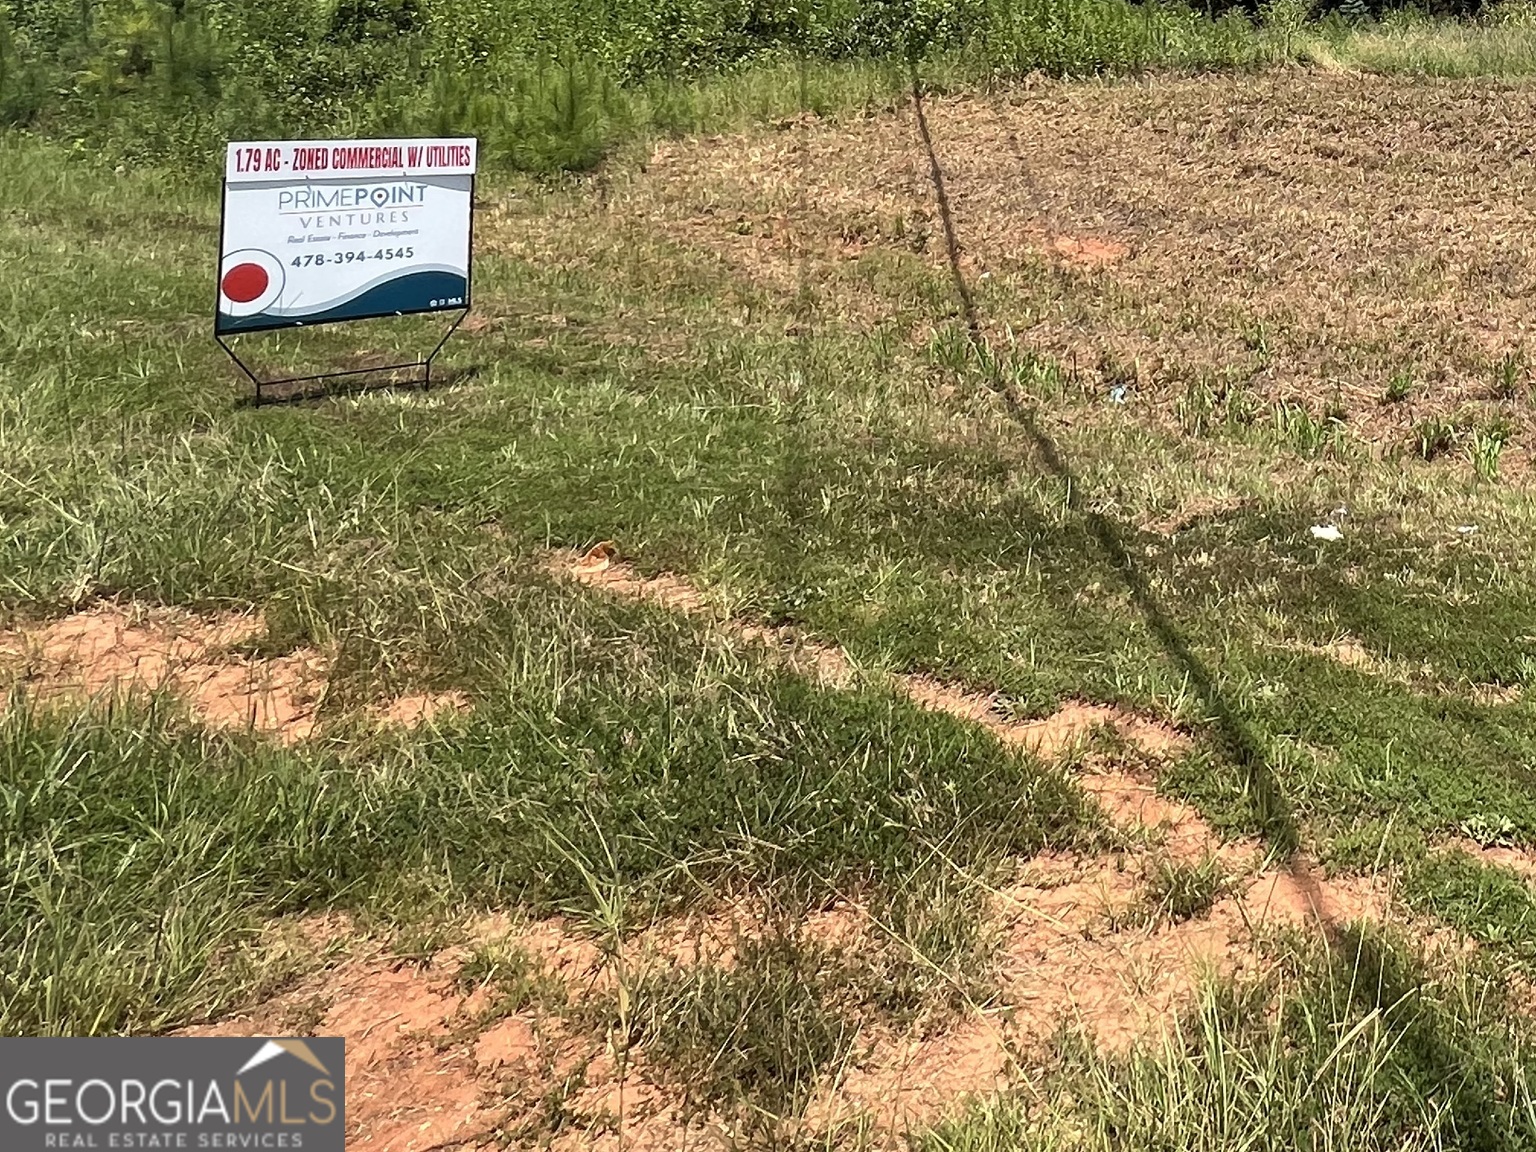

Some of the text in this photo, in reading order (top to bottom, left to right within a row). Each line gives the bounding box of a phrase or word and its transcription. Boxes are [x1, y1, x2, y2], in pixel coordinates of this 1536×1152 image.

[235, 148, 261, 172] 1.79
[264, 148, 281, 172] AC
[292, 147, 329, 171] ZONED
[332, 146, 404, 170] COMMERCIAL
[407, 145, 423, 169] W/
[426, 145, 471, 168] UTILITIES
[278, 185, 428, 210] PRIMEPOINT
[299, 211, 410, 229] VENTURES
[287, 234, 305, 244] Real
[373, 228, 419, 239] Development
[290, 247, 415, 268] 478-394-4545
